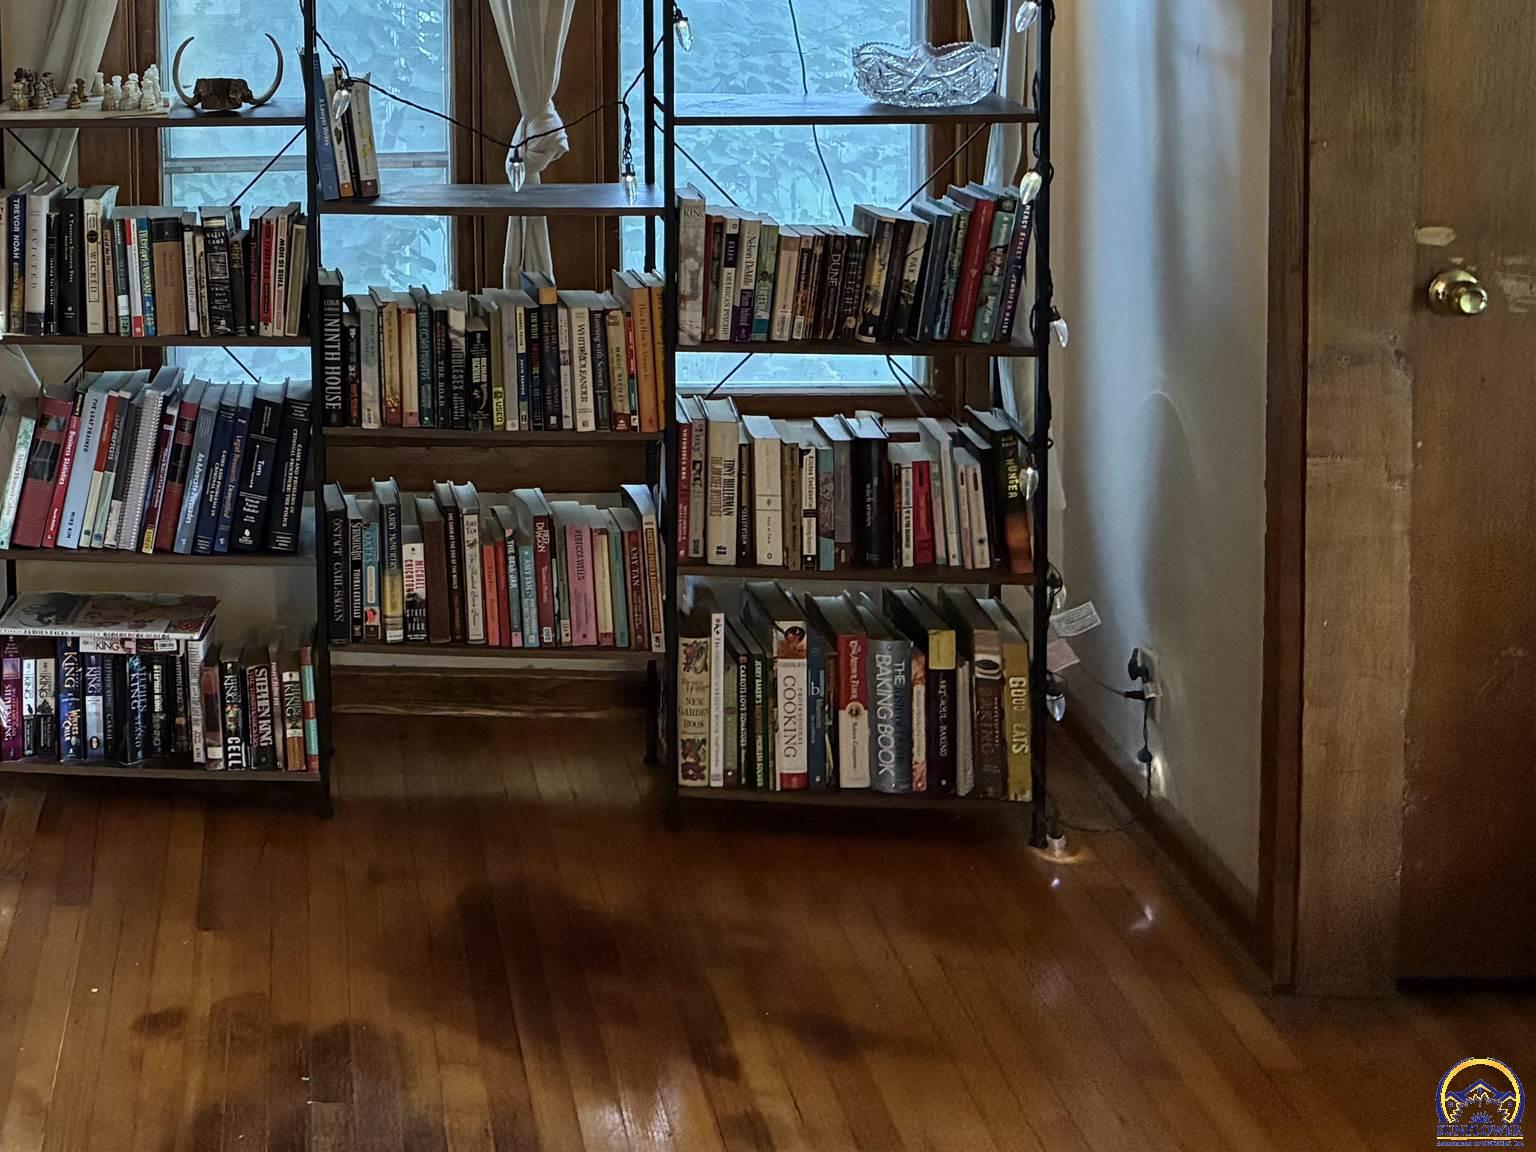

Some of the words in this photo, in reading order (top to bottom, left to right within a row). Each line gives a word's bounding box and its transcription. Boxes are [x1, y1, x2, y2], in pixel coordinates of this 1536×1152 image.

[319, 104, 327, 125] Lawyer
[1021, 205, 1031, 229] MERCY
[728, 240, 736, 261] ELLIS
[745, 236, 756, 259] Nelson
[1015, 232, 1025, 259] STREET
[278, 259, 284, 267] IS
[744, 261, 753, 286] DeMille
[829, 254, 841, 288] DUNE
[908, 257, 917, 273] PAX
[724, 272, 732, 307] AMERICAN
[1007, 274, 1017, 309] JENNIFER
[593, 313, 601, 342] Running
[721, 309, 730, 335] PSYCHO
[323, 318, 340, 360] NINTH
[577, 324, 585, 351] WHITE
[324, 366, 341, 409] HOUSE
[64, 430, 76, 456] Business
[83, 427, 92, 453] TRAINER
[197, 453, 205, 461] An
[256, 460, 264, 476] Torts
[724, 459, 736, 476] TONY
[59, 457, 71, 485] Statistics
[191, 463, 202, 491] Advocate
[210, 462, 219, 489] CRIMINAL
[1005, 457, 1019, 499] HUNGER
[290, 476, 299, 506] PROBLEMS
[723, 479, 736, 516] HILLERMAN
[185, 493, 198, 524] Persuades
[388, 507, 397, 530] LARRY
[535, 522, 546, 552] DRAGON
[542, 529, 550, 544] RED
[574, 529, 583, 559] REBECCA
[507, 555, 515, 572] BELL
[523, 559, 531, 574] AMY
[630, 545, 638, 566] AMY
[333, 562, 344, 589] CARL
[405, 560, 414, 593] CRICHTON
[415, 560, 425, 590] MICHAEL
[508, 573, 517, 589] JAR
[524, 575, 532, 592] TAN
[577, 560, 585, 580] WELLS
[631, 568, 640, 587] TAN
[333, 590, 345, 622] SAGAN
[96, 640, 120, 651] KING
[62, 651, 78, 689] KING
[85, 666, 96, 694] KING
[153, 664, 162, 694] STEPHEN
[754, 660, 762, 678] JERRY
[894, 660, 906, 685] THE
[24, 676, 32, 699] KING
[39, 675, 47, 698] KING
[130, 673, 139, 710] KING
[138, 666, 147, 712] STEPHEN
[224, 675, 234, 703] KING
[255, 668, 270, 717] STEPHEN
[755, 679, 763, 704] BAKER'S
[875, 654, 892, 719] BAKING
[1009, 676, 1026, 711] GOOD
[154, 695, 163, 712] KING
[284, 684, 295, 717] KING
[783, 675, 796, 759] COOKING
[259, 719, 272, 746] KING
[939, 725, 948, 757] BAKING
[1012, 724, 1028, 754] EATS
[227, 736, 241, 767] CELL
[877, 724, 895, 776] BOOK
